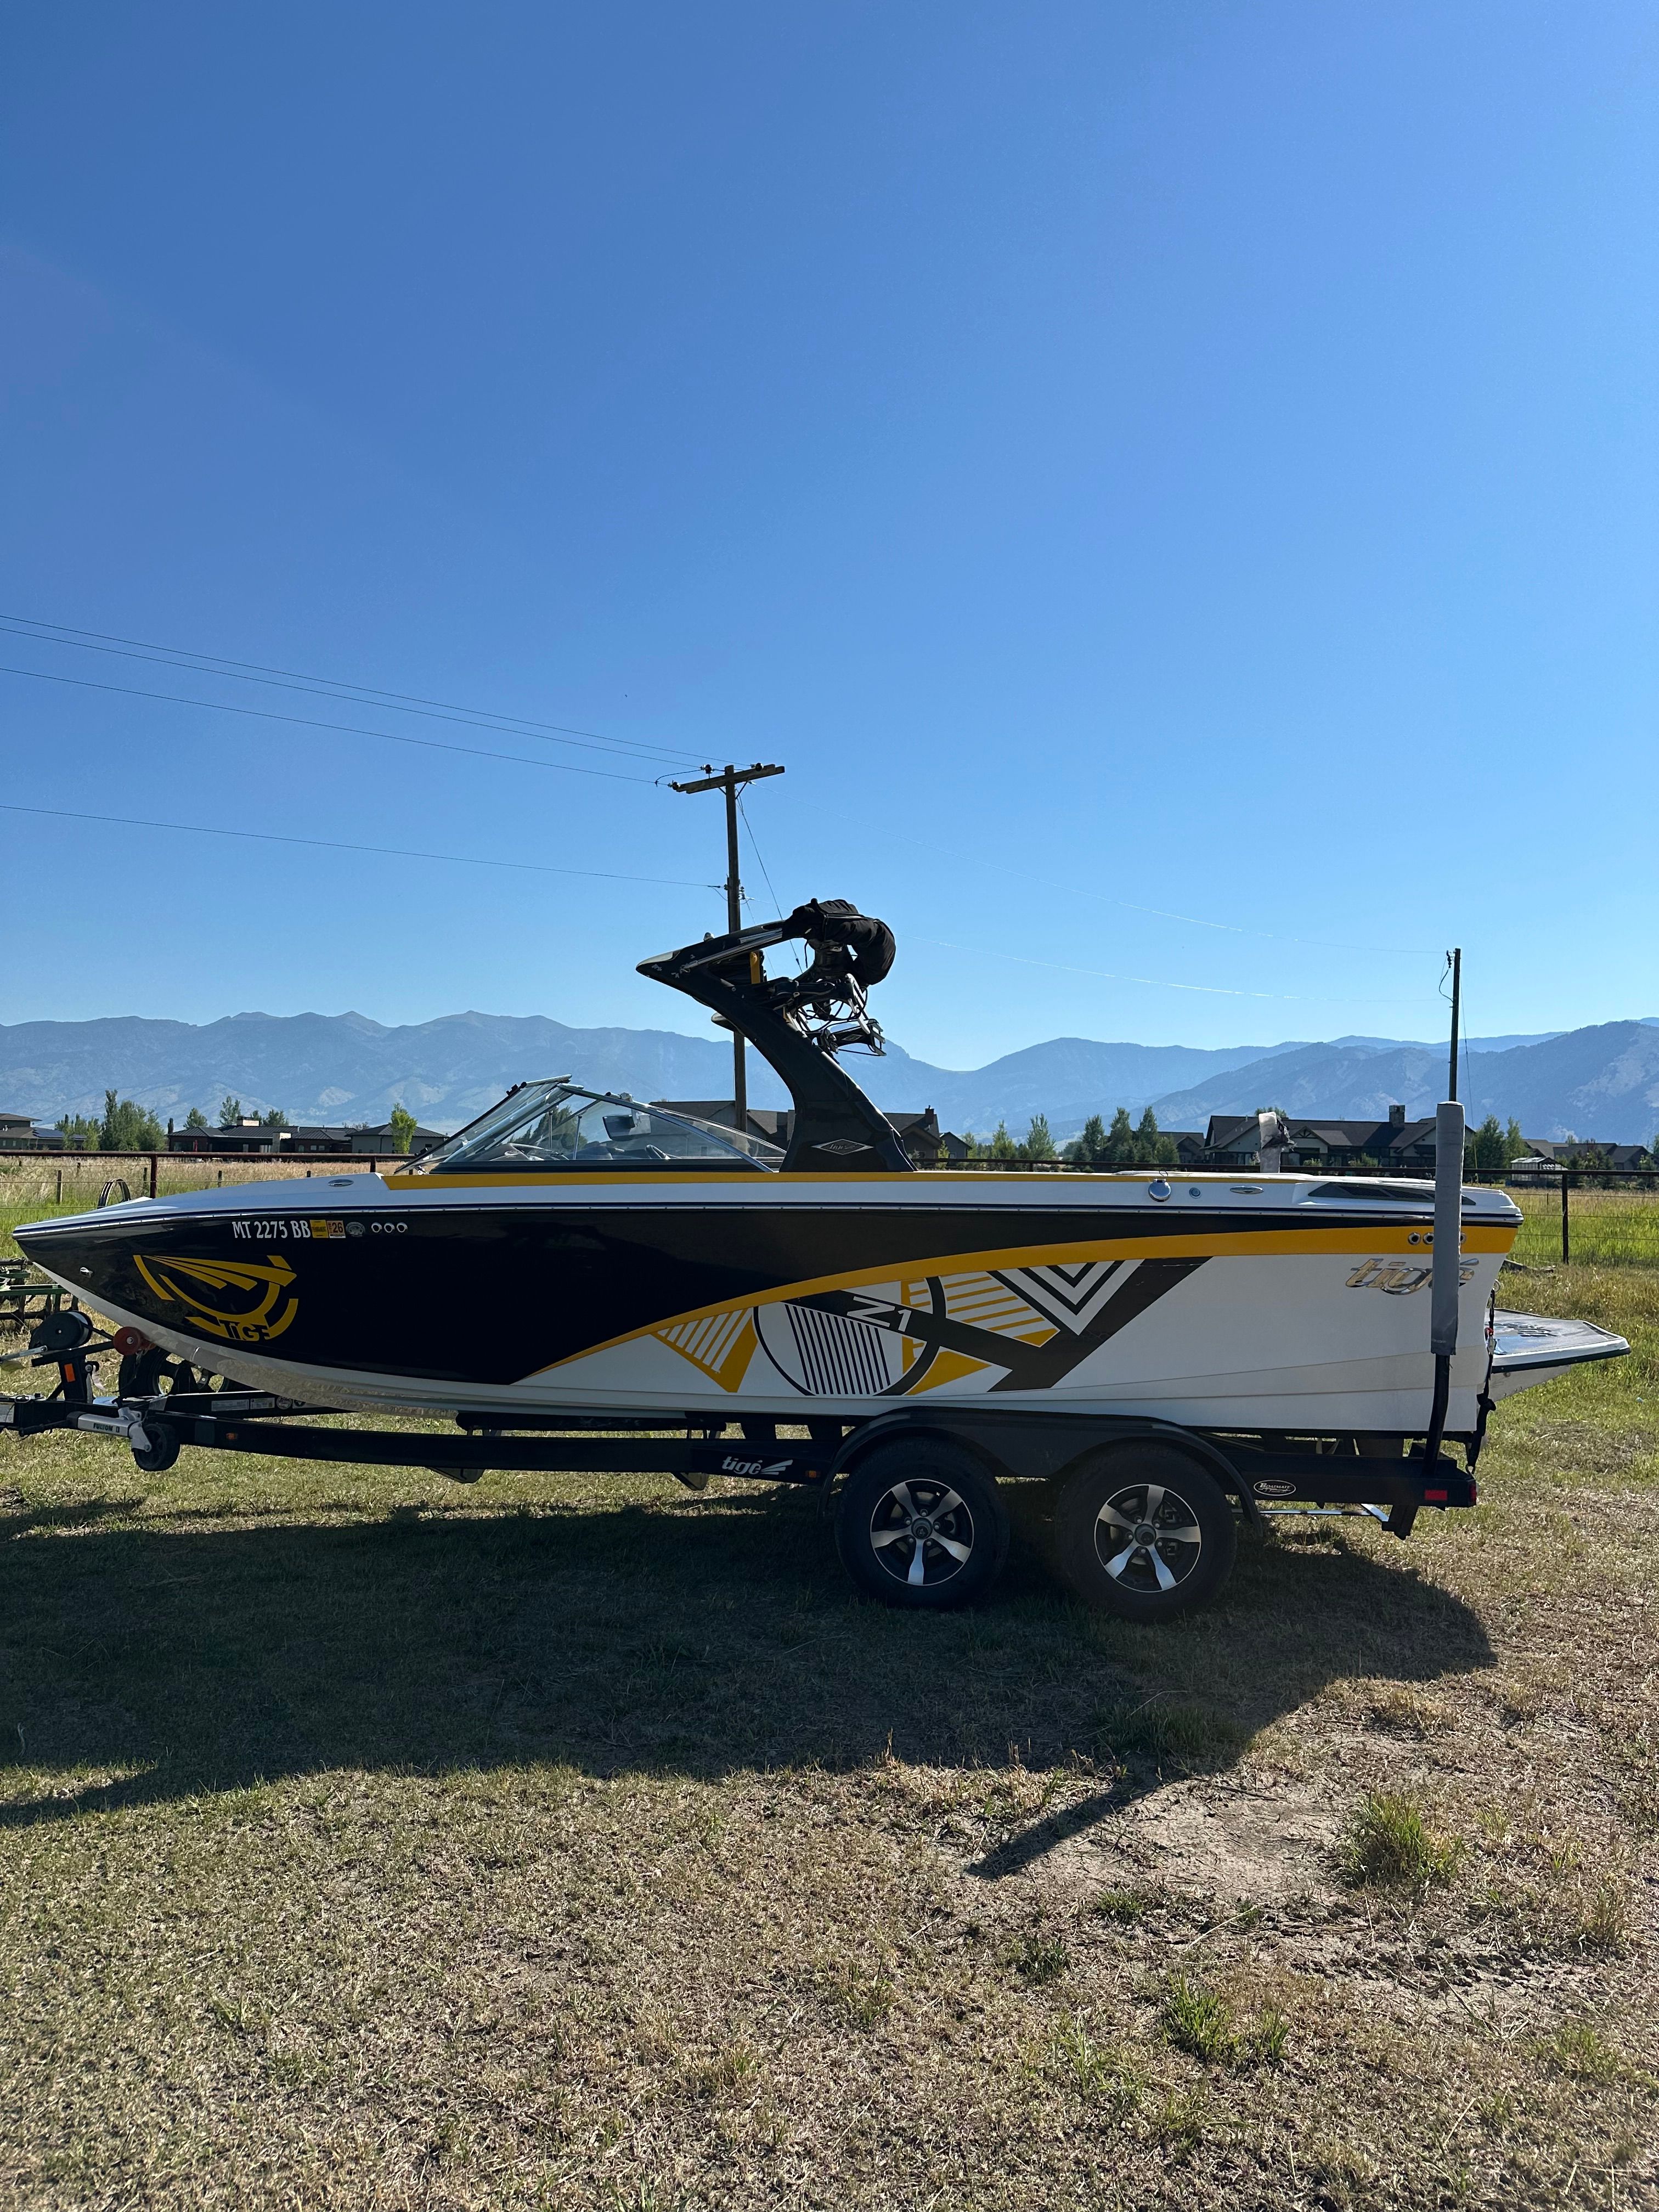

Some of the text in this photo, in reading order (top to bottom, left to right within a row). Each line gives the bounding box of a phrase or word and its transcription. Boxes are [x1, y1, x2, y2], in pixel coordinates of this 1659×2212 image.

[232, 1220, 311, 1238] MT 2275 BB
[332, 1222, 343, 1233] 26
[847, 1296, 912, 1332] Z1
[93, 1422, 113, 1431] FULTON
